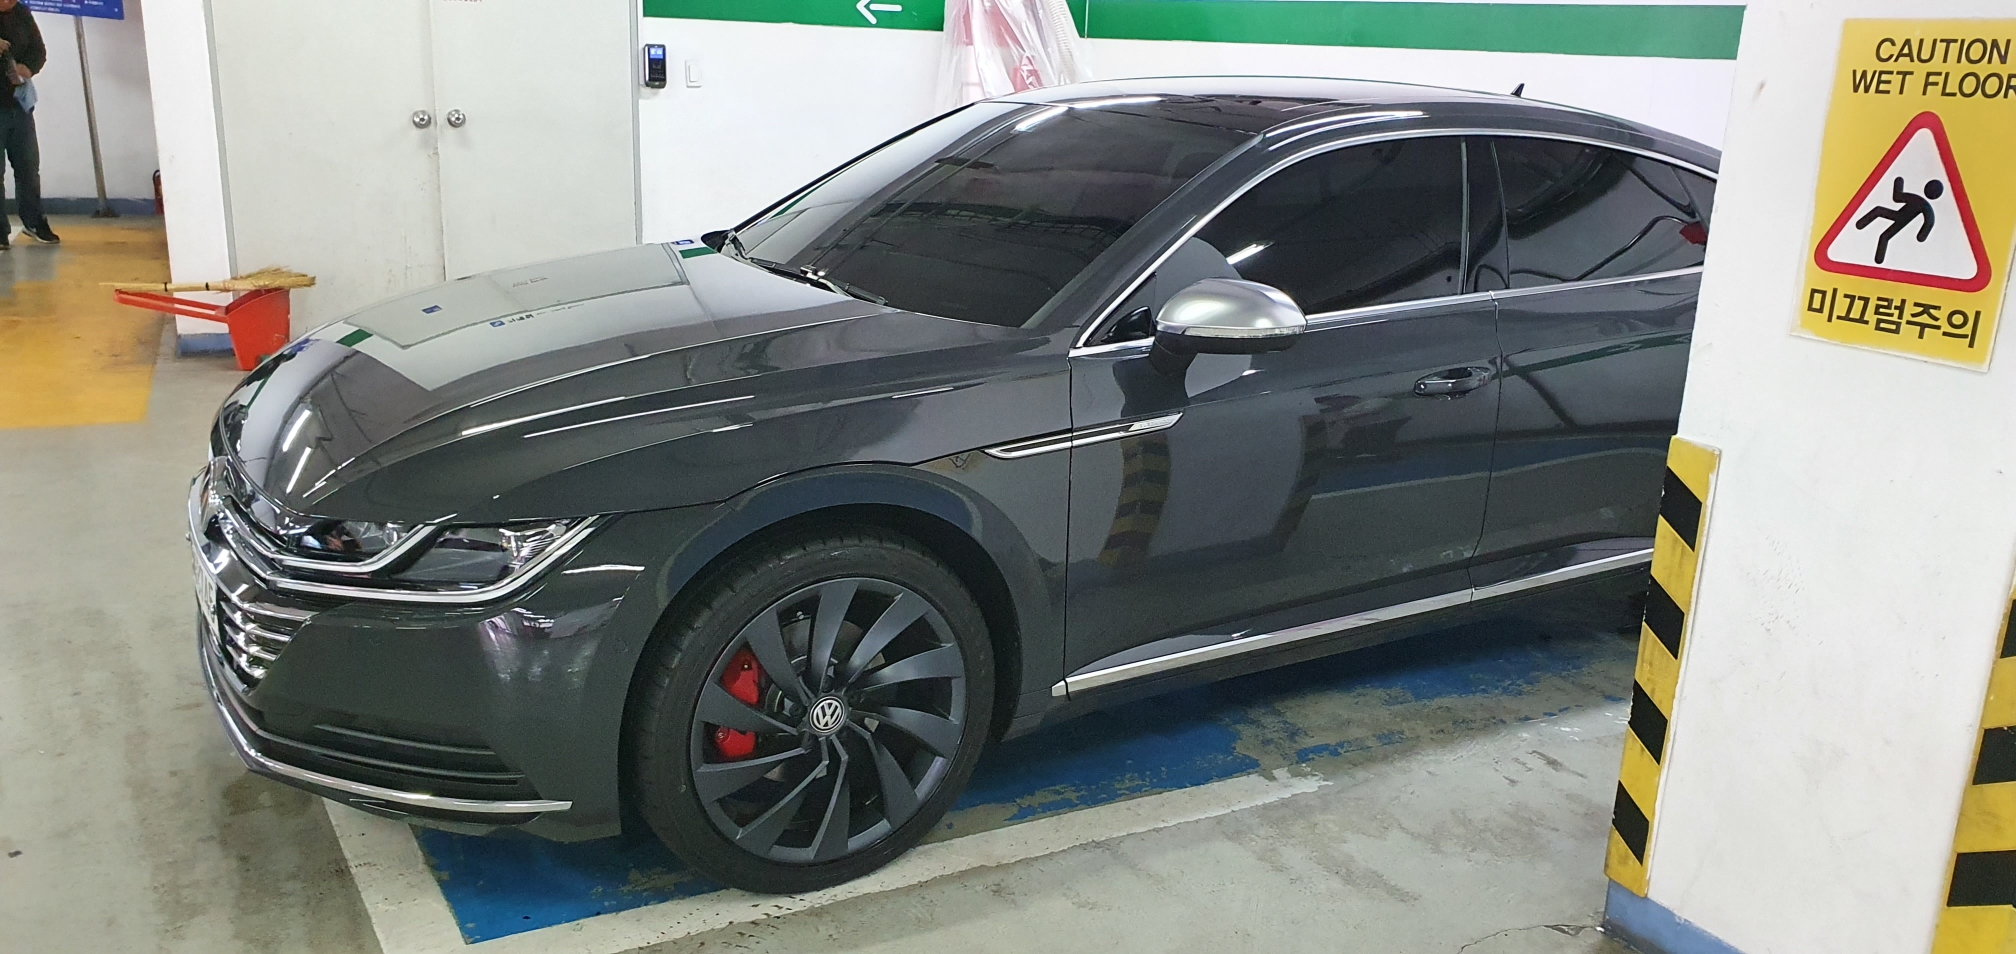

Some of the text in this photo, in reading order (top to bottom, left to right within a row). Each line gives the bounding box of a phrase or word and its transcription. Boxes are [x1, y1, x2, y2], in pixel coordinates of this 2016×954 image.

[1875, 37, 2012, 65] CAUTION
[1851, 69, 1915, 95] WET
[1806, 287, 1982, 349] 미끄럼주의
